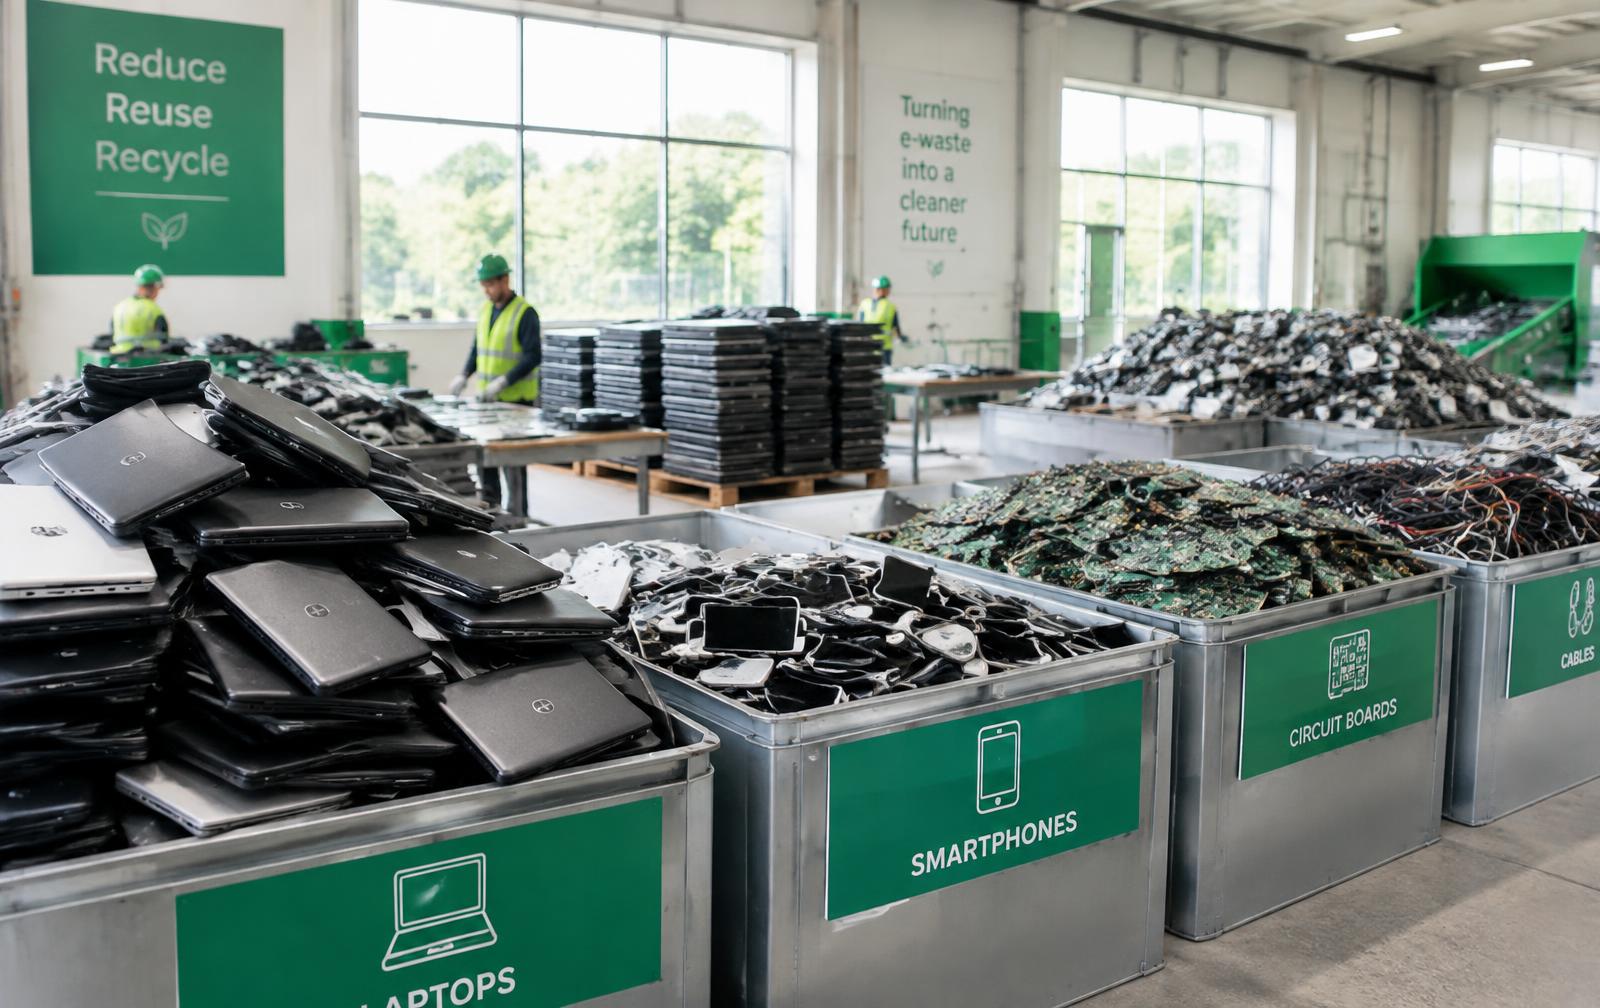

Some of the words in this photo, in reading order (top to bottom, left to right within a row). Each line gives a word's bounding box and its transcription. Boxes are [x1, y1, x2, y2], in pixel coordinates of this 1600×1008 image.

[95, 42, 227, 84] Reduce
[106, 92, 213, 129] Reuse
[900, 94, 970, 129] Turning
[900, 131, 972, 153] e-waste
[95, 139, 229, 182] Recycle
[902, 157, 938, 181] into
[944, 166, 955, 182] a
[900, 188, 967, 213] cleaner
[902, 218, 957, 243] future
[1561, 645, 1595, 669] CABLES
[1289, 714, 1343, 748] CIRCUIT
[1345, 697, 1398, 730] BOARDS
[911, 810, 1079, 877] SMARTPHONES
[360, 966, 516, 1008] PTOPS
